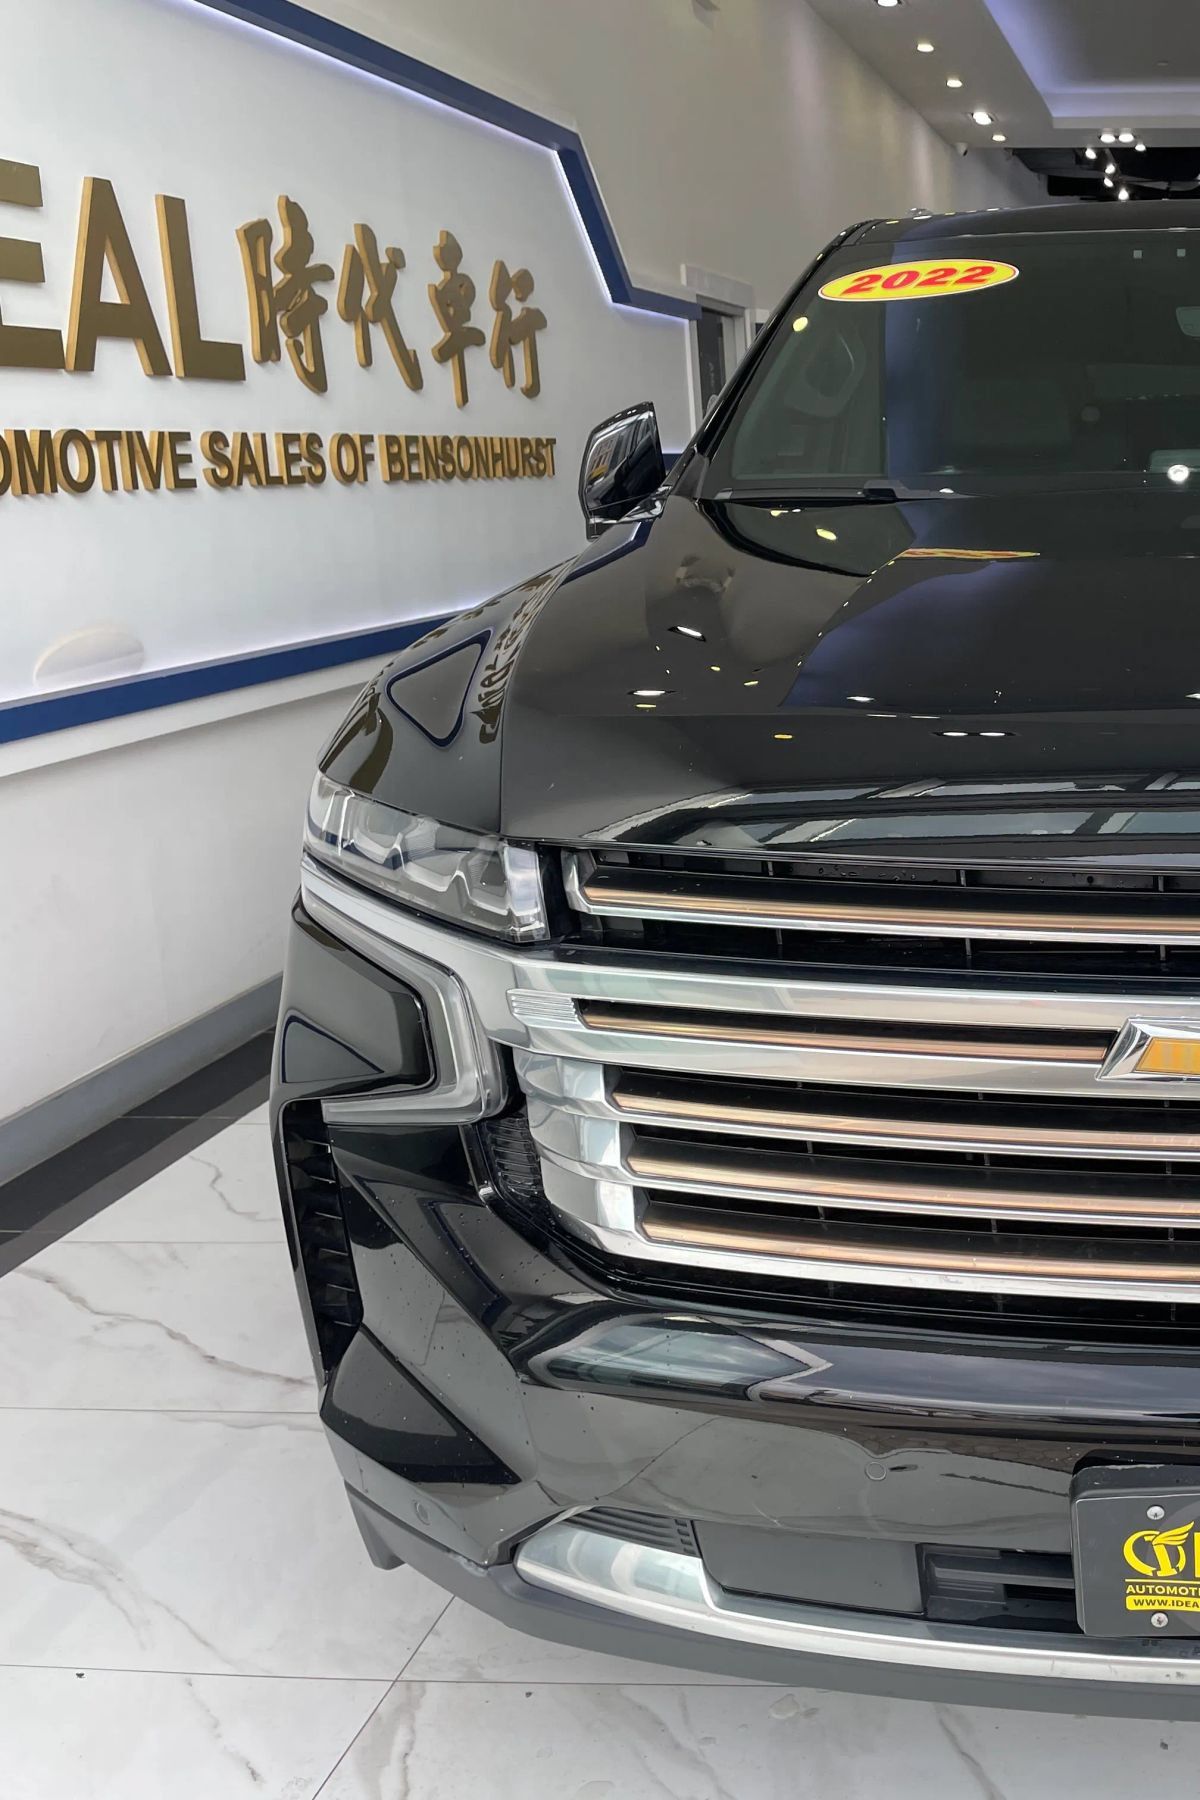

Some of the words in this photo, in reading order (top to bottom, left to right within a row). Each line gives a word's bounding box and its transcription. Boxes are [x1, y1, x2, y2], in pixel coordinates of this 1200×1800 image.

[840, 266, 996, 296] 2022
[200, 430, 327, 488] SALES
[329, 432, 375, 484] OF
[378, 434, 557, 483] BENSONHURST
